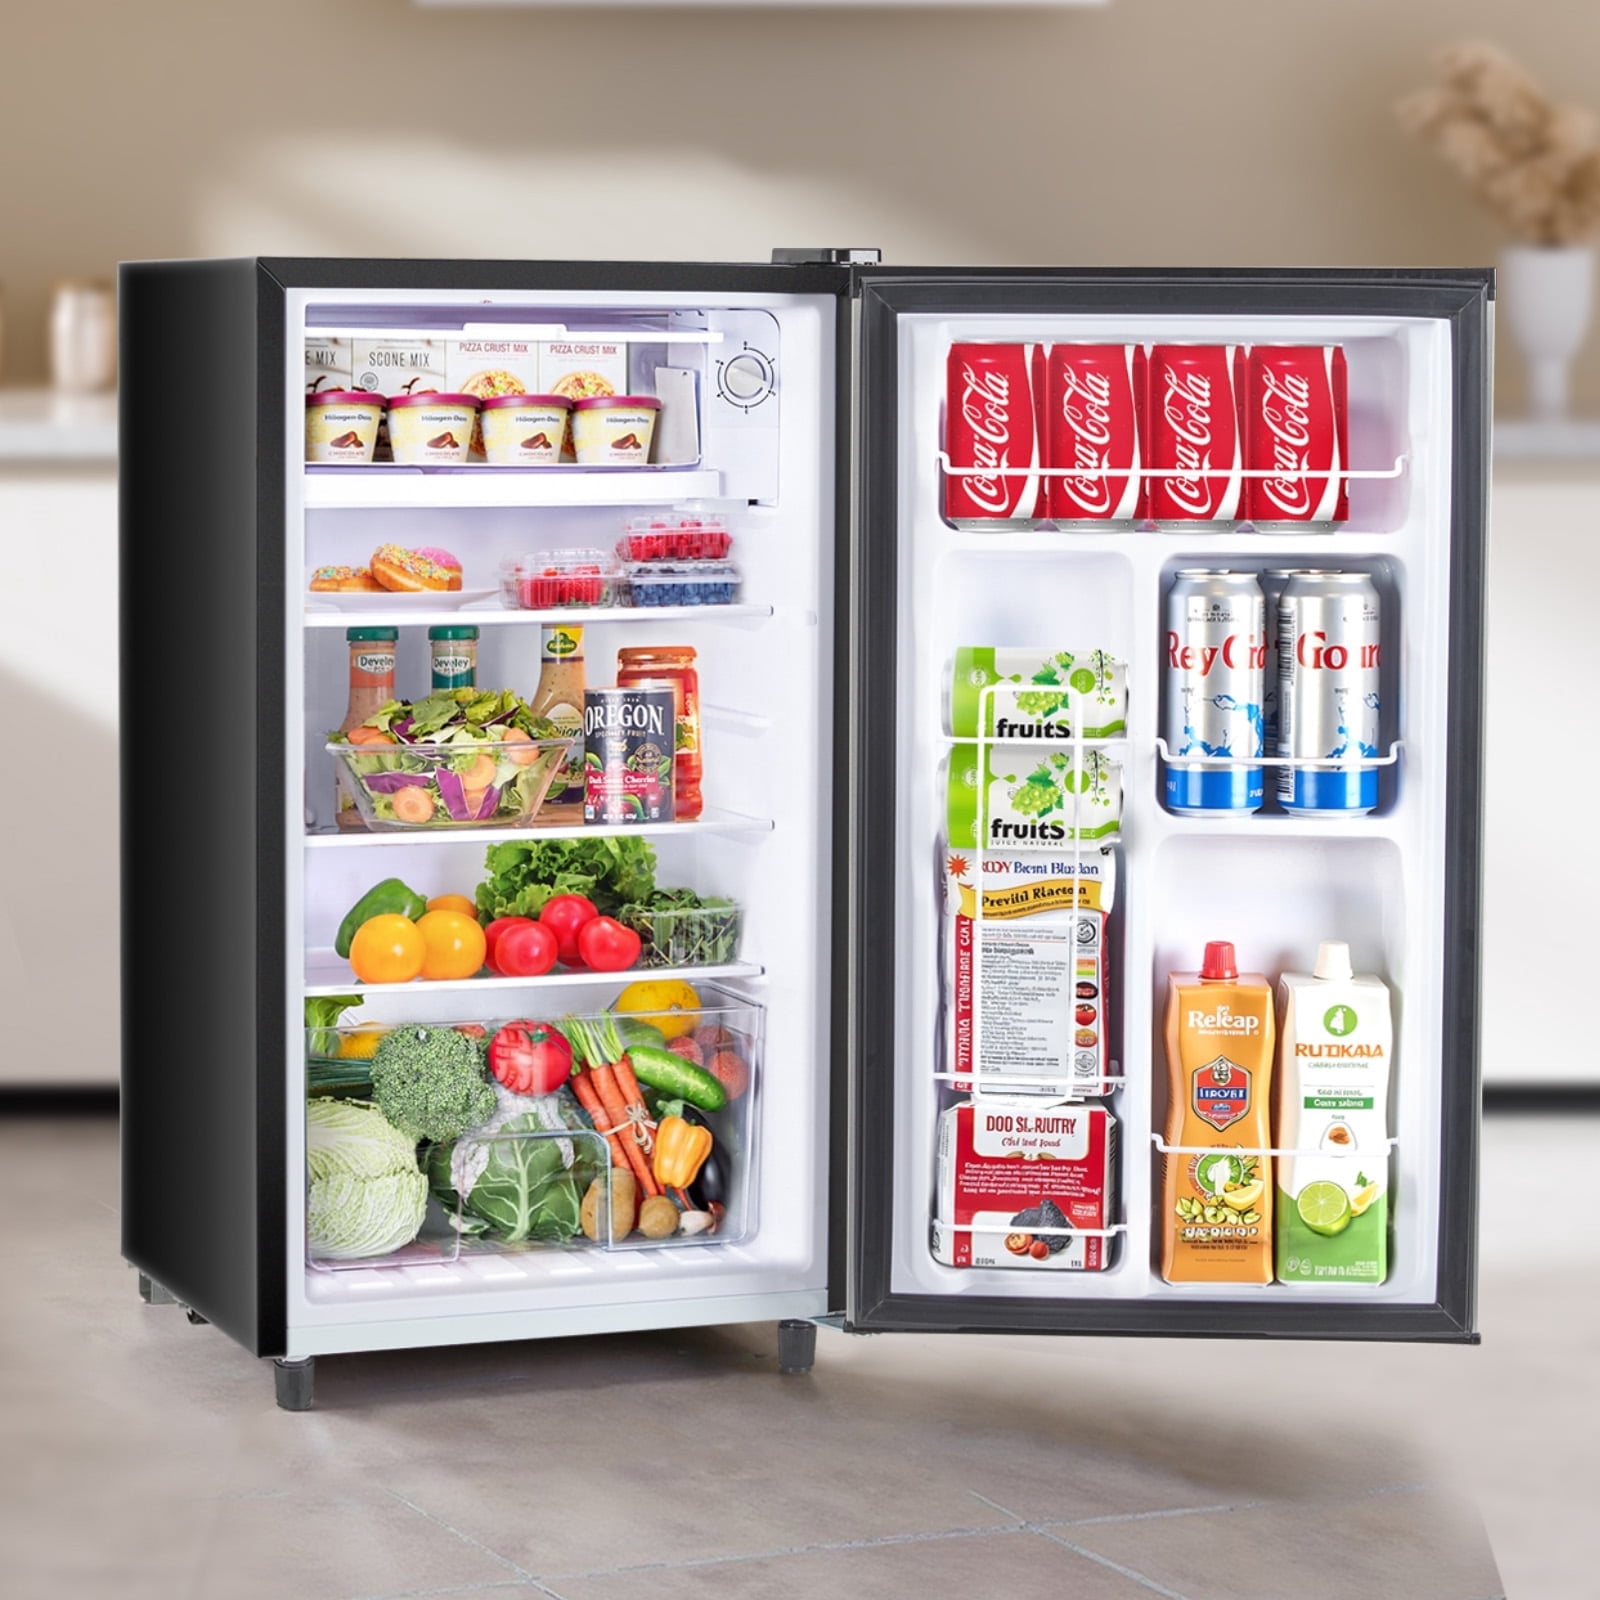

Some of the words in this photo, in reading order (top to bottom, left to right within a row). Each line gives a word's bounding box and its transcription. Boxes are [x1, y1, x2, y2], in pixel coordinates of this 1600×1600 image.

[459, 342, 482, 353] PIZZA
[484, 342, 511, 353] CRUST
[513, 343, 529, 353] MIX
[550, 344, 573, 355] PIZZA
[574, 344, 600, 355] CRUST
[602, 345, 617, 355] MIX
[316, 351, 337, 366] MIX
[368, 351, 405, 368] SCONE
[409, 353, 430, 368] MIX
[584, 704, 666, 737] OREGON
